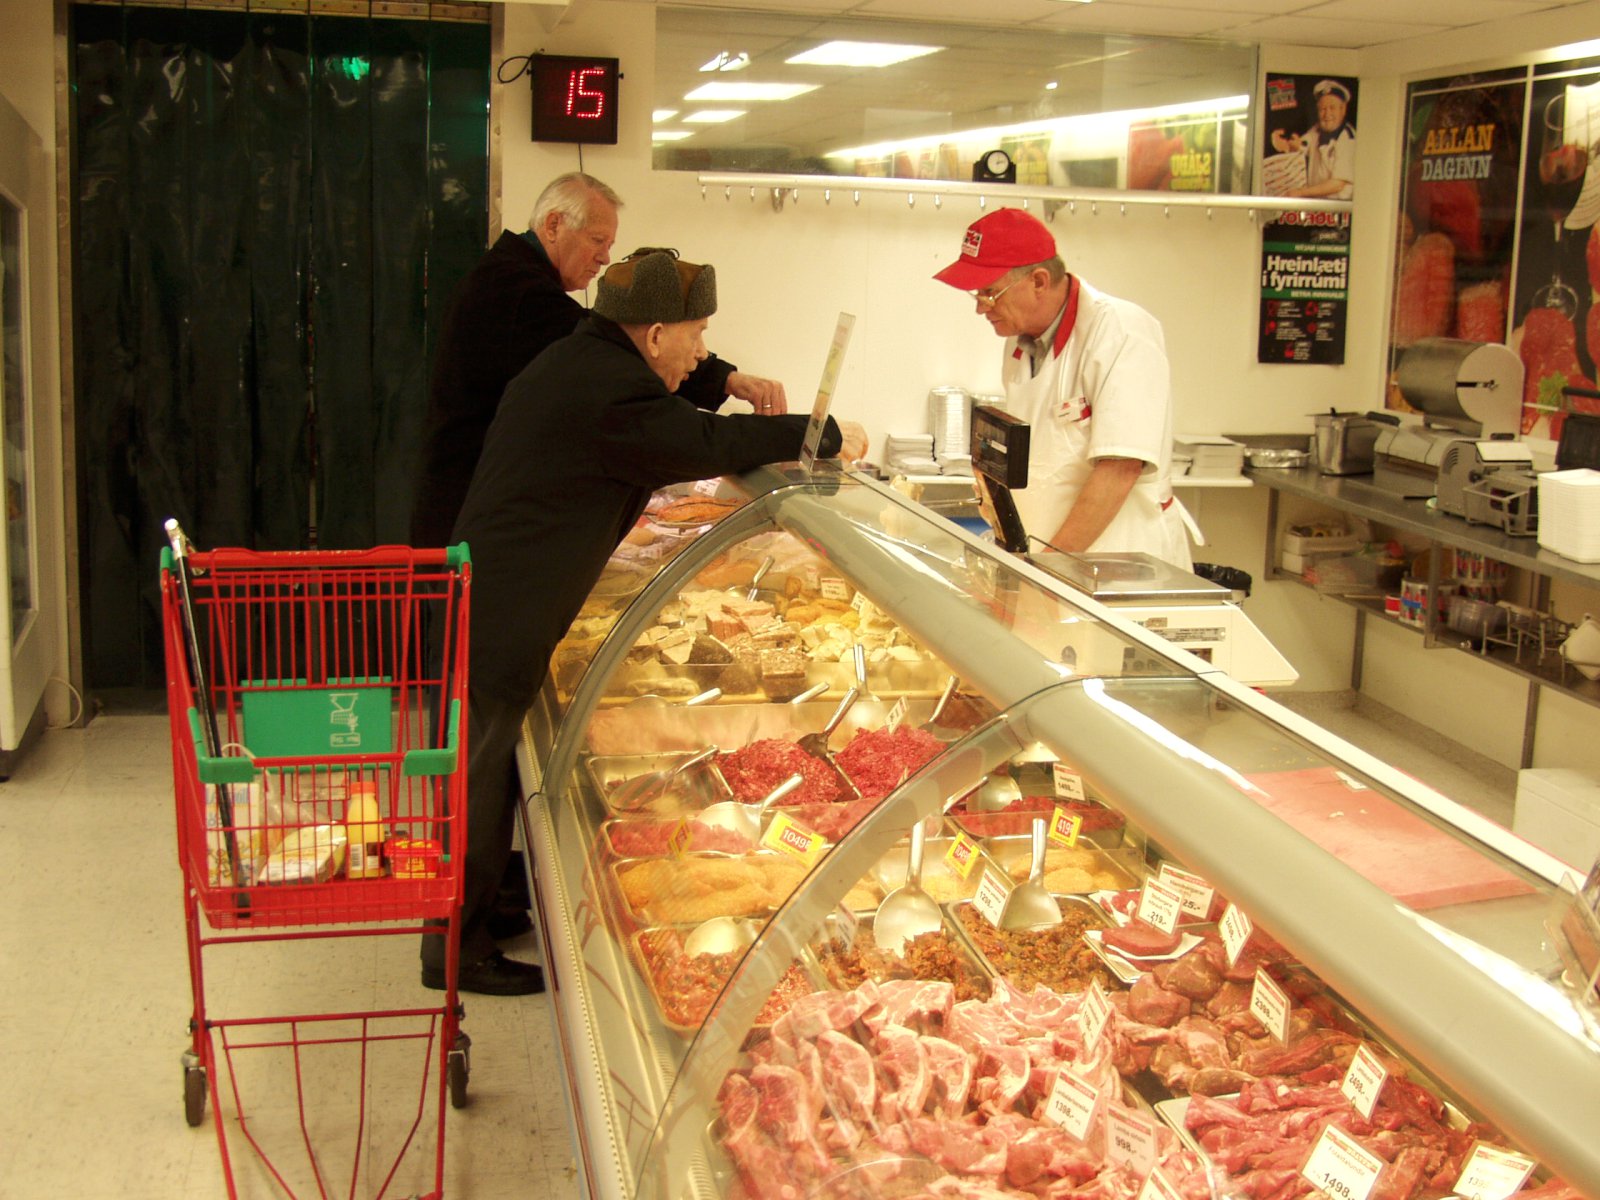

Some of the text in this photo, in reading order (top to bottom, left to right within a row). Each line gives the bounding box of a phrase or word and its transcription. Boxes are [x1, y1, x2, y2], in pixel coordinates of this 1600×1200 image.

[565, 70, 605, 118] 15
[1423, 124, 1496, 155] ALLAN
[1421, 154, 1493, 182] DAGINN
[1267, 255, 1347, 274] Hreinlæti
[1270, 271, 1346, 291] fyrirrúmi
